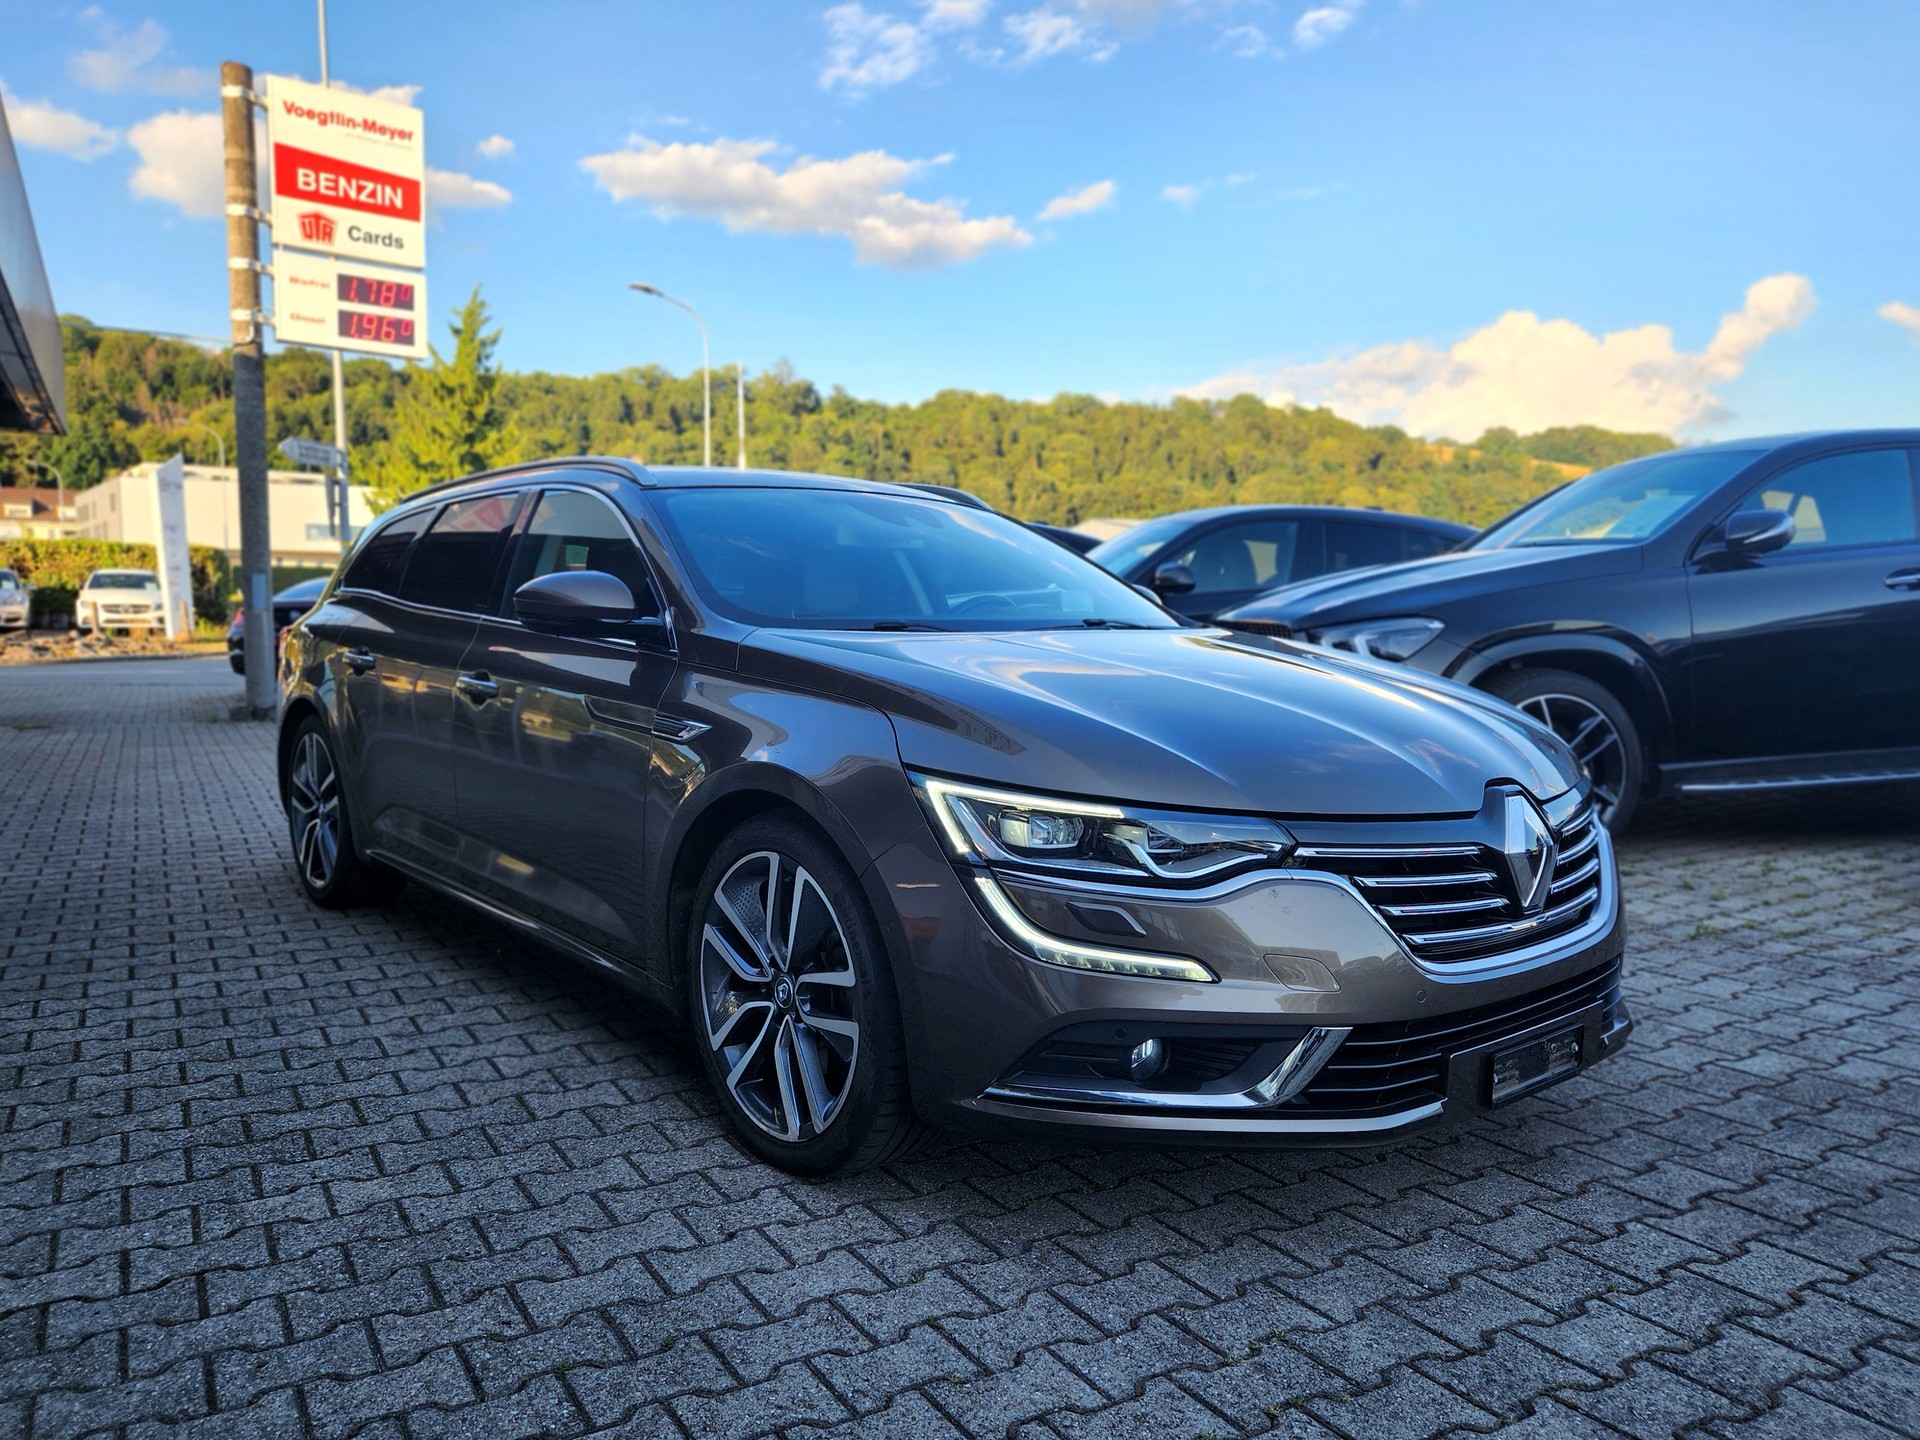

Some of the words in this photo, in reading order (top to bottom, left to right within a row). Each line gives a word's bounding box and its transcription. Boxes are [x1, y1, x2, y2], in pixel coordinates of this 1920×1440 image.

[282, 99, 414, 142] Voegtlin-Meyer
[297, 167, 403, 209] BENZIN
[347, 225, 405, 250] Cards
